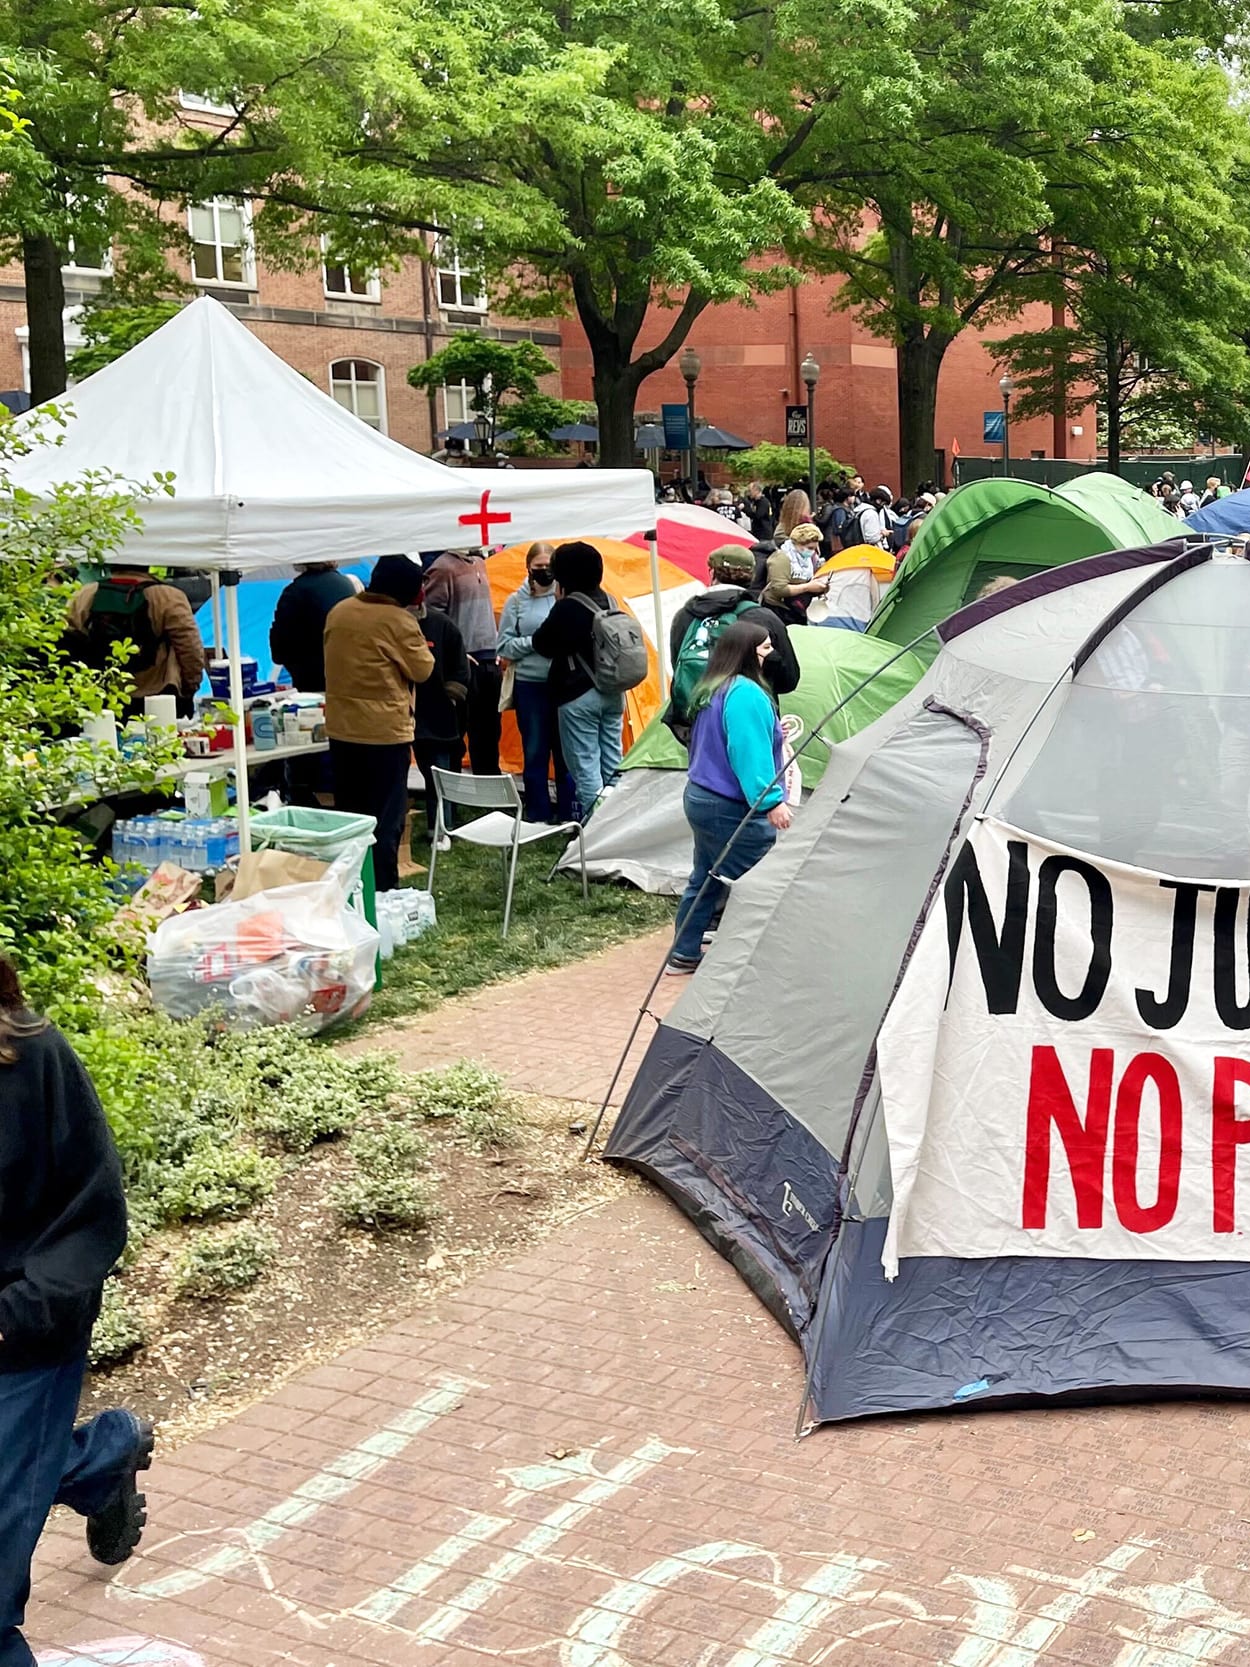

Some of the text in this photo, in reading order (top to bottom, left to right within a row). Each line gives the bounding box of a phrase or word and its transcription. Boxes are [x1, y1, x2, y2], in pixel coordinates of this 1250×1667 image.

[787, 419, 807, 434] REVS
[943, 839, 1113, 1021] NO
[1022, 1045, 1182, 1233] NO
